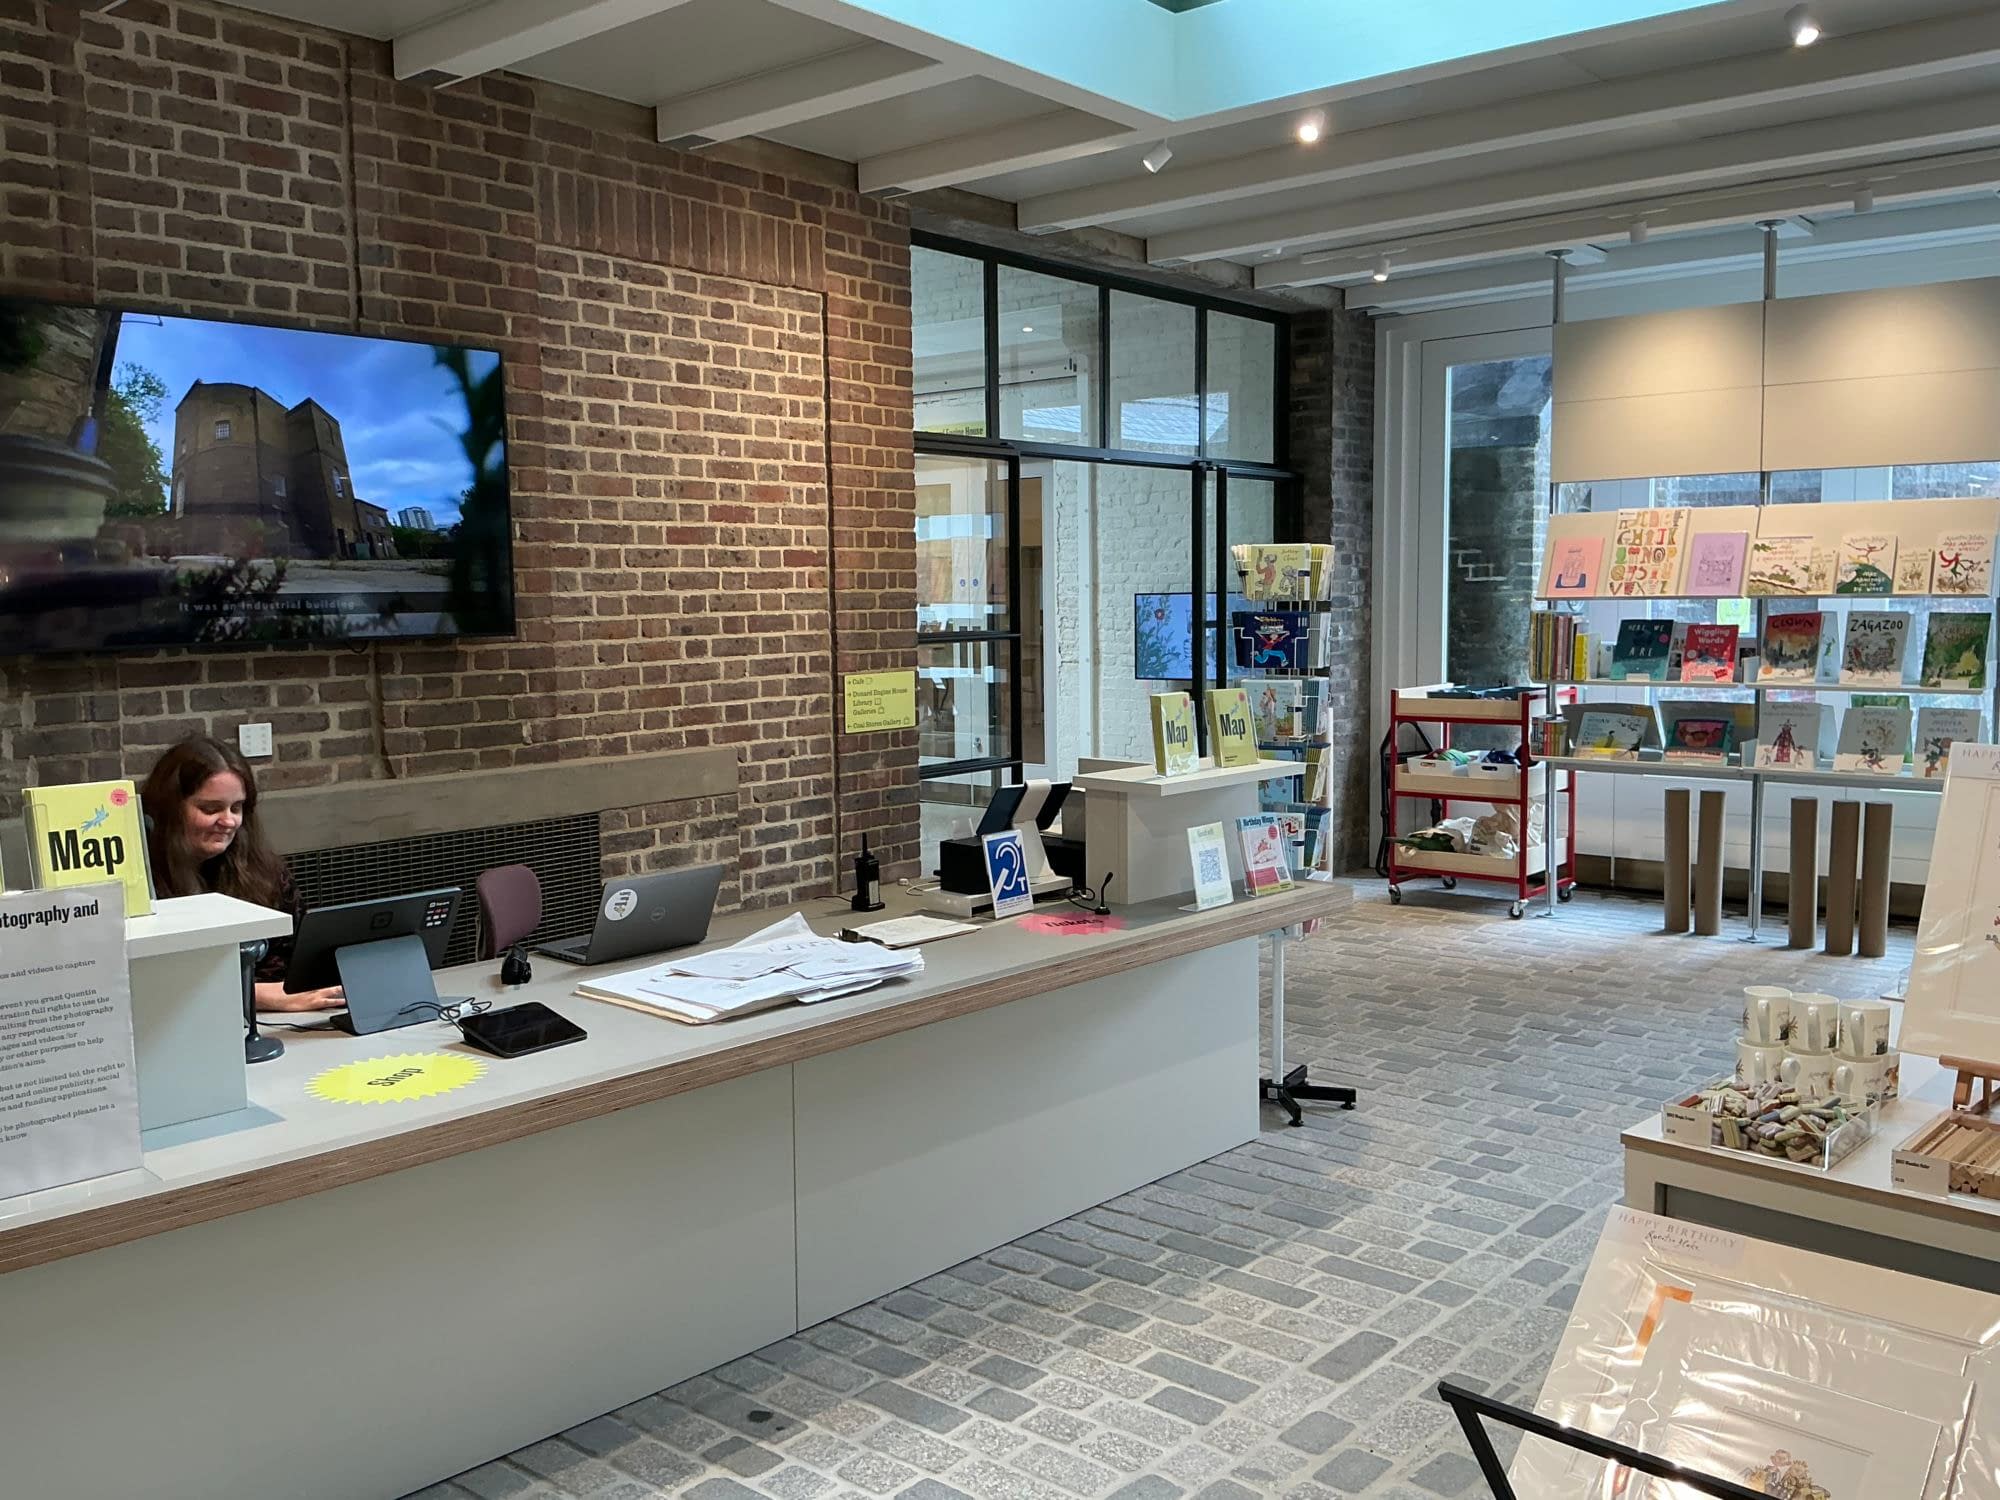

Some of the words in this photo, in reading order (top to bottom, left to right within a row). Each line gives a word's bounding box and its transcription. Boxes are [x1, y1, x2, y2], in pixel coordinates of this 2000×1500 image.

[193, 603, 217, 611] was
[223, 603, 237, 611] an
[305, 600, 355, 610] building
[1628, 624, 1646, 632] HERE
[1653, 624, 1665, 632] WE
[1772, 617, 1815, 629] CLOWN
[1850, 619, 1904, 633] ZAGAZOO
[1694, 628, 1730, 637] Wiggling
[1629, 647, 1653, 657] ARE
[852, 699, 873, 707] Library
[852, 708, 877, 716] Galleries
[882, 719, 901, 727] Gallery
[1219, 713, 1246, 741] Map
[1166, 720, 1188, 748] Map
[48, 829, 125, 875] Map
[1017, 876, 1026, 892] T
[0, 904, 70, 929] tography
[74, 899, 99, 918] and
[1041, 919, 1105, 928] Tickets
[11, 969, 26, 977] and
[27, 966, 54, 974] videos
[64, 960, 96, 969] capture
[24, 999, 39, 1007] you
[40, 995, 64, 1004] grant
[64, 989, 97, 999] Quentin
[28, 1017, 48, 1026] from
[49, 1014, 62, 1022] the
[63, 1006, 114, 1020] photography
[31, 1006, 46, 1014] full
[47, 1003, 71, 1012] rights
[2, 1033, 16, 1041] any
[18, 1023, 76, 1039] reproductions
[16, 1049, 39, 1058] other
[40, 1043, 76, 1055] purposes
[87, 1036, 104, 1045] help
[21, 1038, 37, 1047] and
[38, 1035, 65, 1044] videos
[24, 1079, 37, 1087] not
[38, 1073, 67, 1084] limited
[97, 1064, 116, 1073] right
[367, 1067, 426, 1087] Shop
[15, 1090, 31, 1099] and
[33, 1086, 58, 1095] online
[97, 1072, 120, 1082] social
[7, 1102, 23, 1110] and
[25, 1096, 57, 1108] funding
[15, 1112, 71, 1130] photographed
[72, 1107, 98, 1119] please
[98, 1103, 109, 1111] let
[1618, 1213, 1661, 1230] HAPPY
[1667, 1224, 1737, 1248] BIRTHDAY
